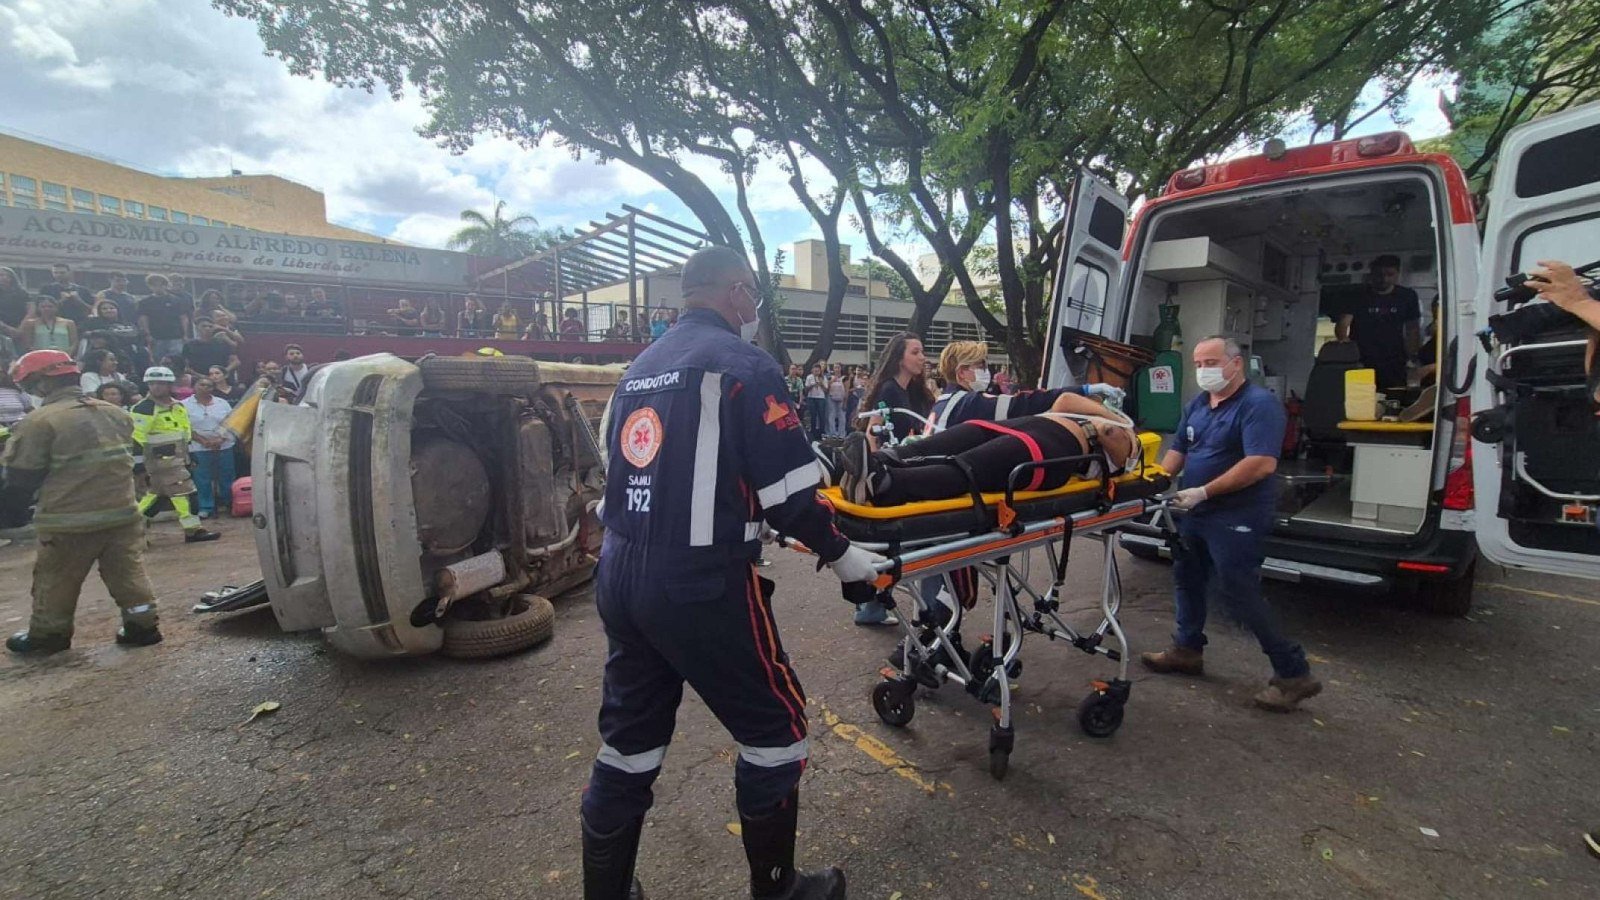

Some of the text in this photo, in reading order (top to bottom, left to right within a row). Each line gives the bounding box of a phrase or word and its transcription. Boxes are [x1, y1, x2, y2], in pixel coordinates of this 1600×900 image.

[23, 215, 200, 246] ACADÊMICO
[215, 233, 329, 256] ALFREDO
[339, 244, 421, 266] BALENA
[113, 246, 162, 258] como
[172, 248, 242, 264] prática
[253, 255, 275, 267] de
[625, 371, 680, 392] CONDUTOR
[628, 475, 651, 486] SAMU
[626, 488, 651, 512] 192
